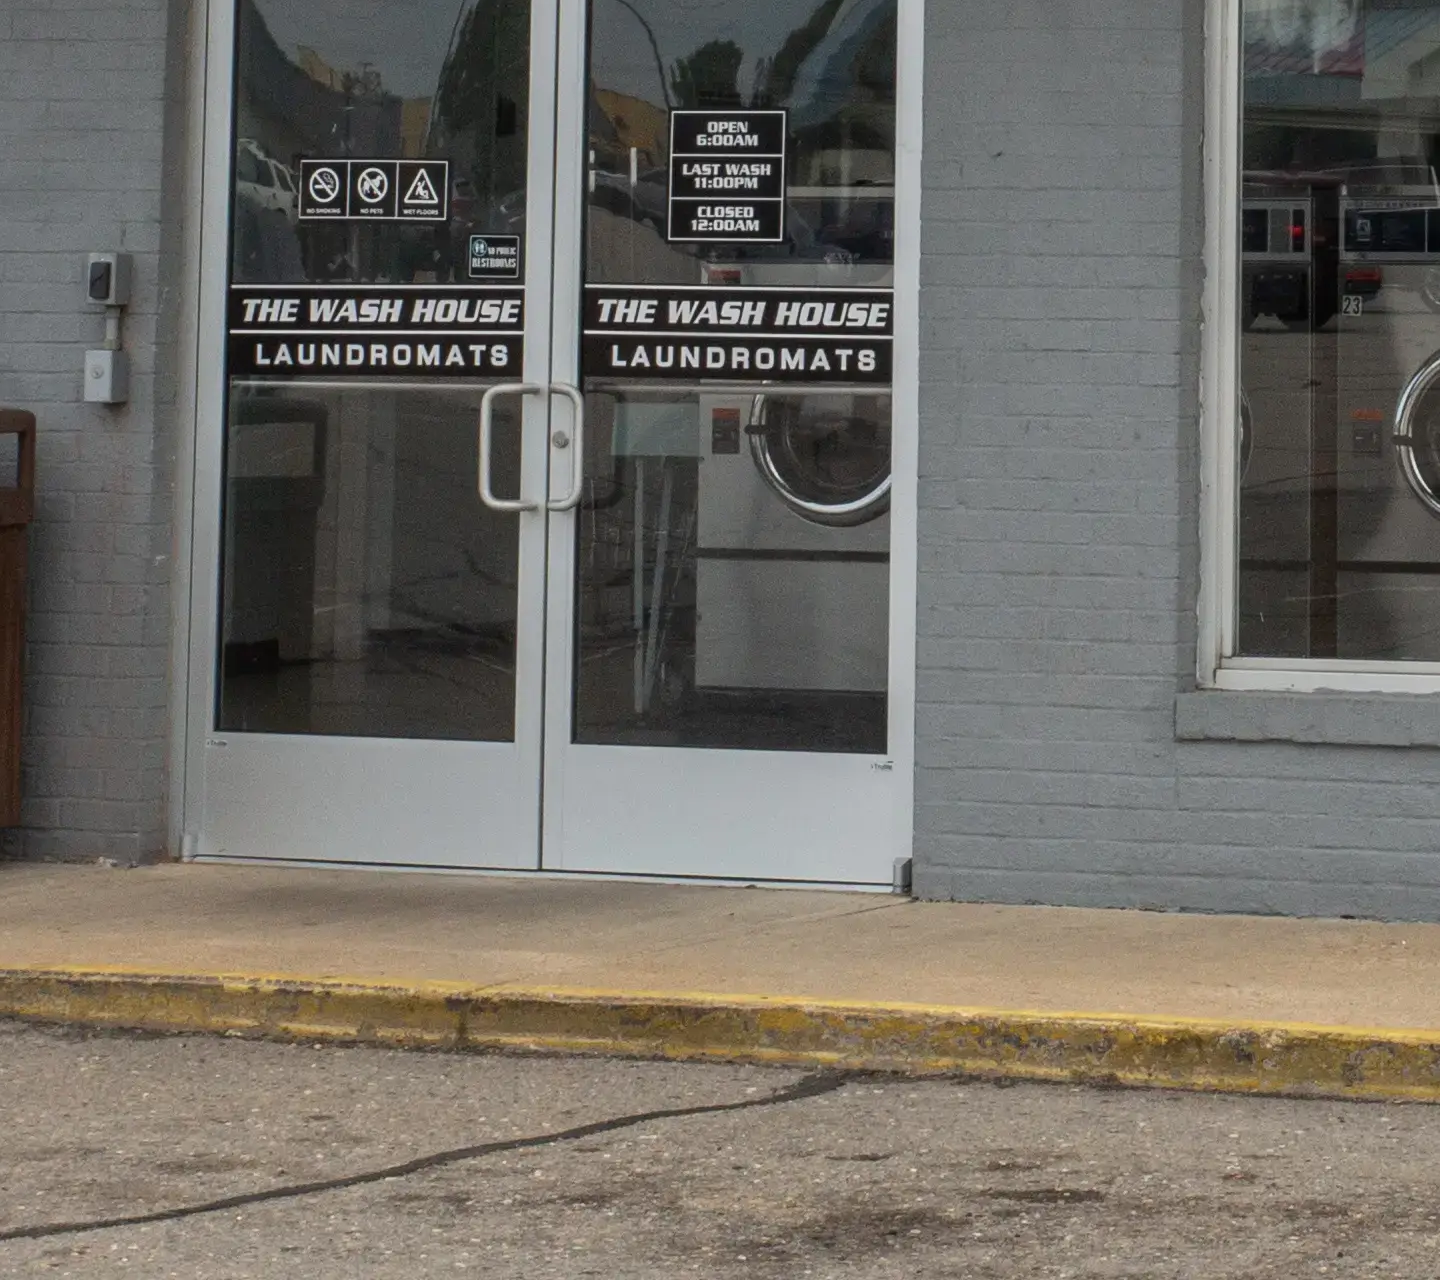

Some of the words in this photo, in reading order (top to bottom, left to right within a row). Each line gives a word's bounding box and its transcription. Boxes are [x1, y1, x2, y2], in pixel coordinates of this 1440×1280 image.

[707, 121, 748, 133] OPEN
[696, 134, 759, 146] 6:00AM
[682, 163, 721, 176] LAST
[725, 163, 771, 176] WASH
[694, 177, 758, 189] 11:00PM
[697, 206, 754, 218] CLOSED
[691, 219, 760, 231] 12:00AM
[242, 298, 303, 324] THE
[308, 298, 404, 324] WASH
[410, 298, 521, 325] HOUSE
[1342, 296, 1362, 315] 23
[597, 299, 659, 325] THE
[666, 299, 763, 326] WASH
[773, 301, 889, 327] HOUSE
[255, 343, 509, 368] LAUNDROMATS
[611, 344, 876, 371] LAUNDROMATS
